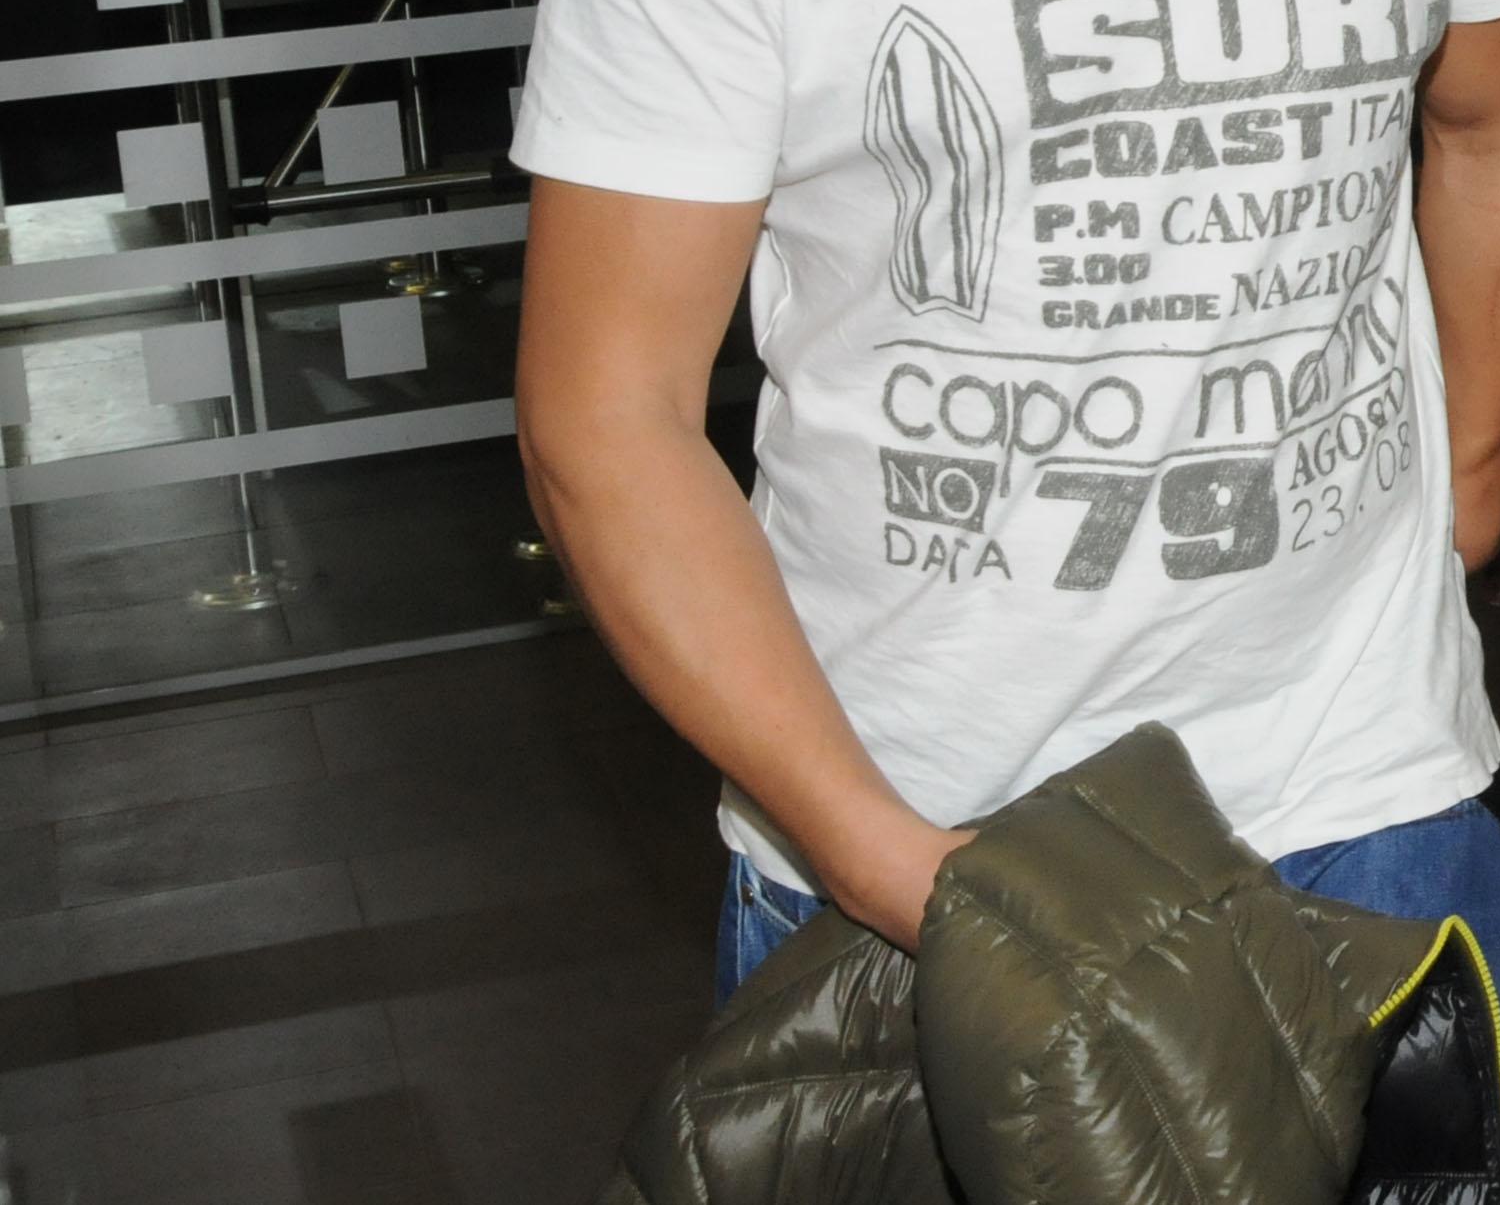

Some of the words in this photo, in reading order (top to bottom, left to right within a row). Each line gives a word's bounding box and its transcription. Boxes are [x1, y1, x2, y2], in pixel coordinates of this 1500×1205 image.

[1029, 101, 1332, 185] COAST
[1033, 200, 1140, 243] P.M
[1160, 161, 1393, 246] CAMPION
[1037, 252, 1151, 287] 3.00
[1041, 293, 1221, 330] GRANDE
[883, 521, 1013, 583] DATA
[1035, 456, 1280, 591] 79
